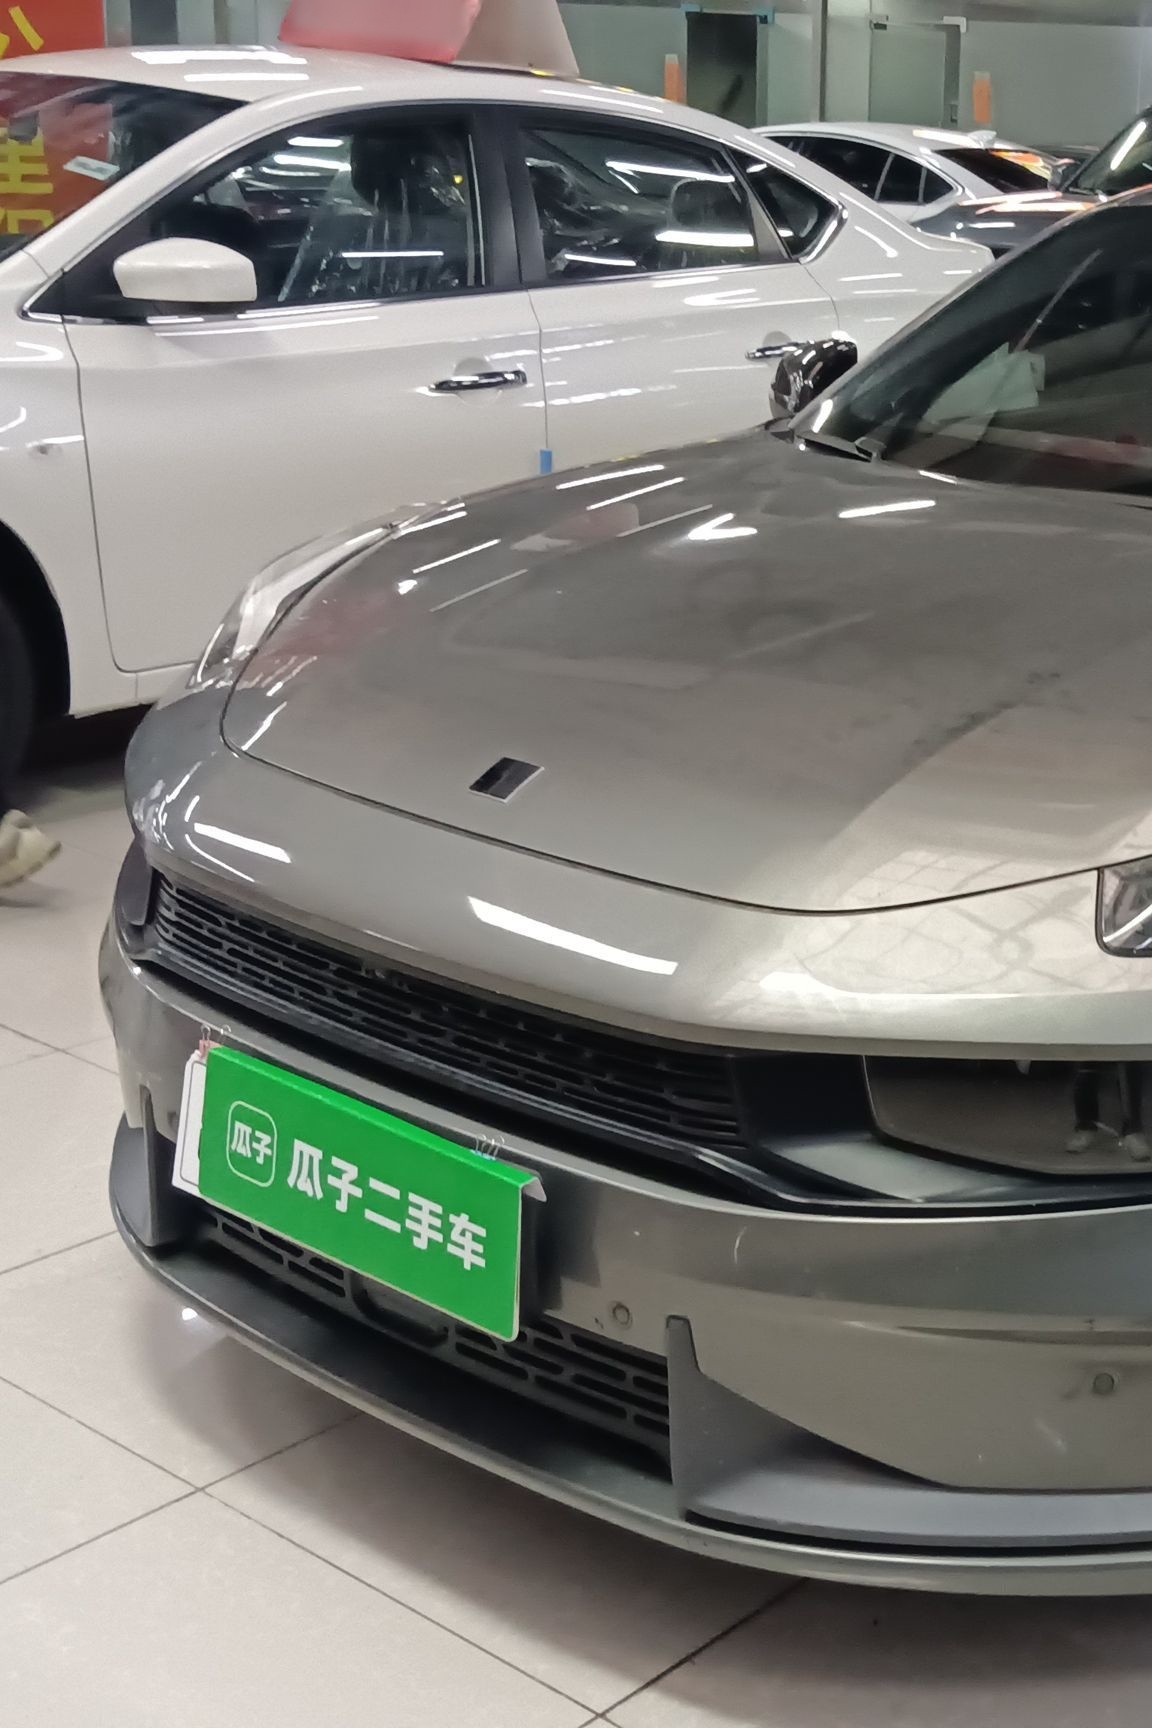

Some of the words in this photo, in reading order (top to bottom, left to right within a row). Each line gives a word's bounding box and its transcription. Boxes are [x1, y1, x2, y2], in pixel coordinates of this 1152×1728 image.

[231, 1120, 272, 1165] 瓜子
[286, 1138, 487, 1271] 瓜子二手车
